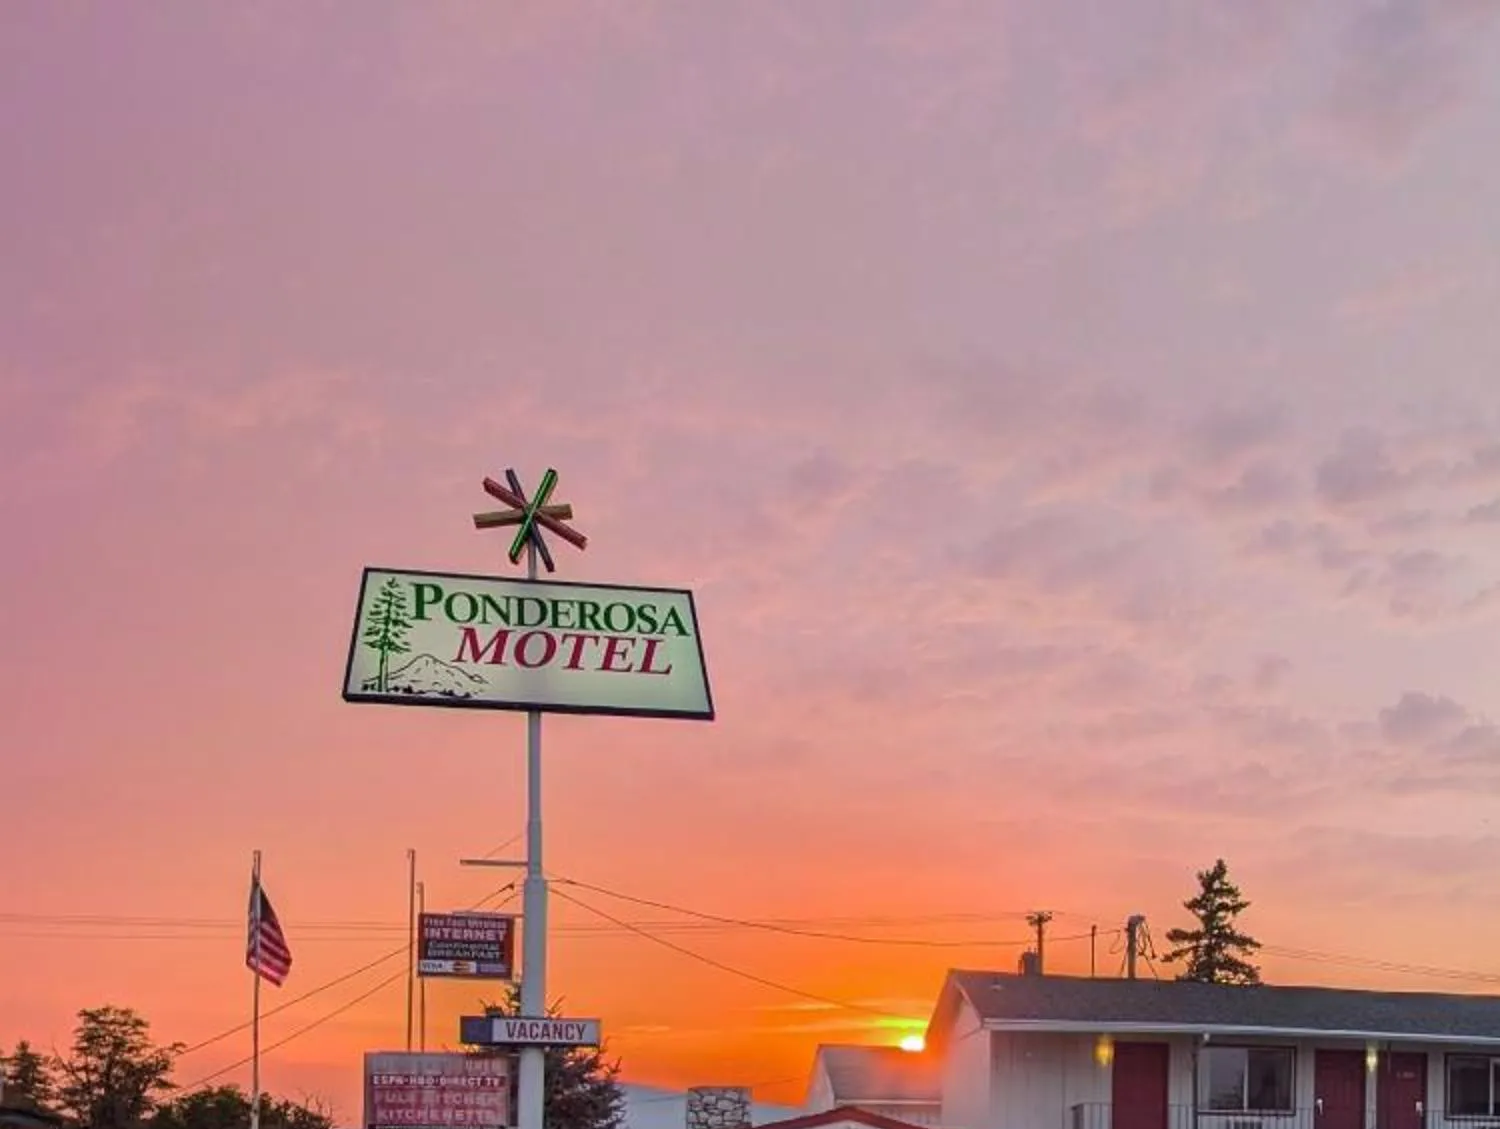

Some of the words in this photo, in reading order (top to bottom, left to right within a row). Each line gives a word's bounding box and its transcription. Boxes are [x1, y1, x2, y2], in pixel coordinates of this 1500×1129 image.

[410, 582, 691, 636] PONDEROSA
[451, 627, 673, 675] MOTEL
[423, 927, 507, 941] INTERNET
[506, 1021, 586, 1040] VACANCY
